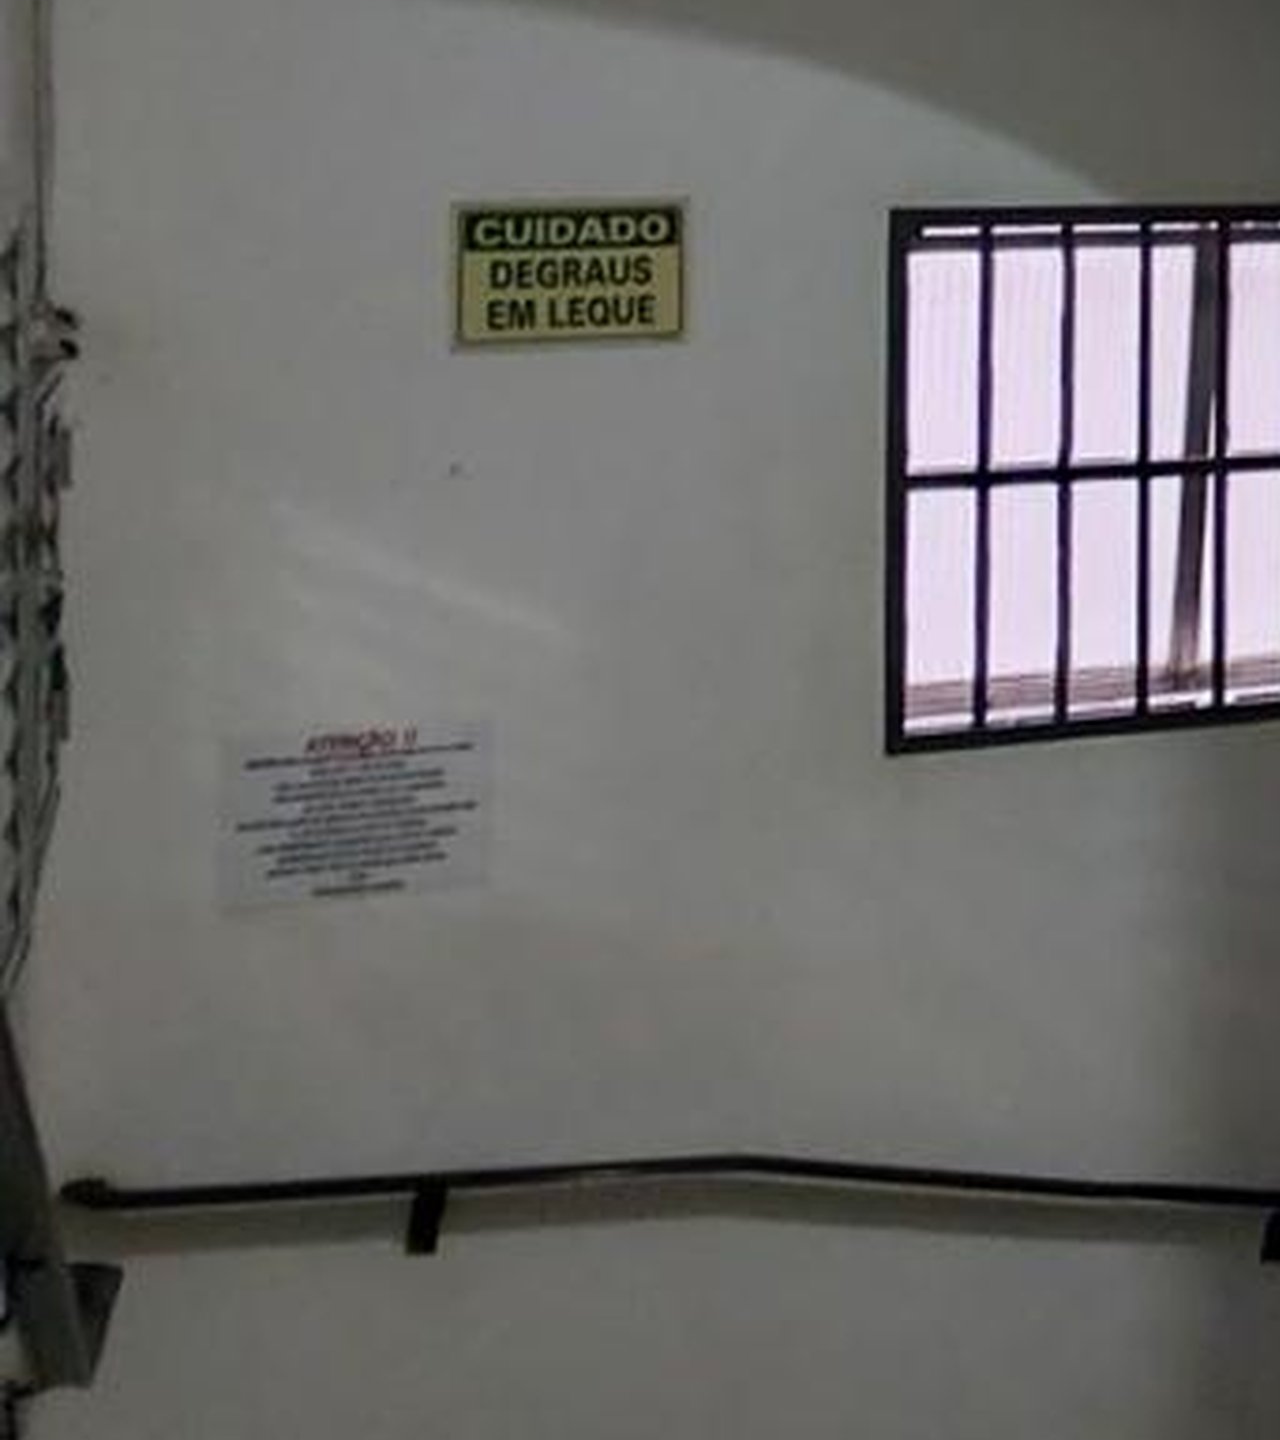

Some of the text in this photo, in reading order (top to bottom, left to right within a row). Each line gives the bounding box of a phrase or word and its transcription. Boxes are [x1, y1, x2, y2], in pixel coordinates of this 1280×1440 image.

[474, 214, 670, 246] CUIDADO
[489, 254, 654, 290] DEGRAUS
[487, 295, 656, 331] EM LEQUE
